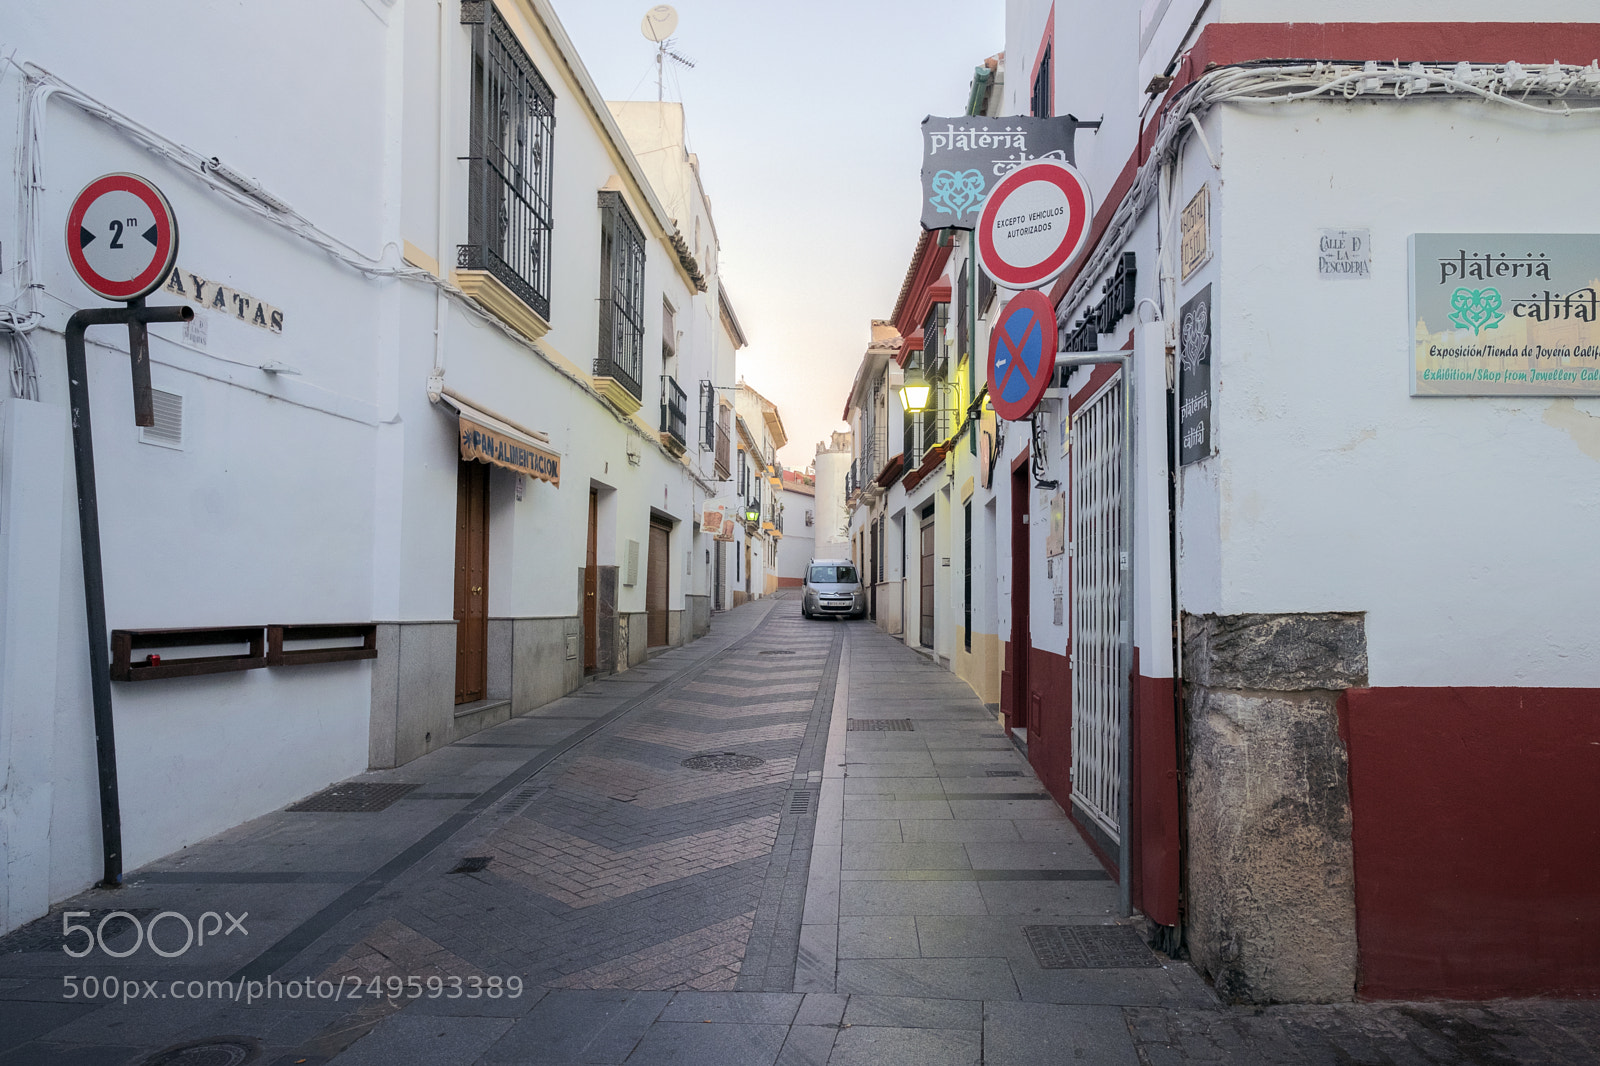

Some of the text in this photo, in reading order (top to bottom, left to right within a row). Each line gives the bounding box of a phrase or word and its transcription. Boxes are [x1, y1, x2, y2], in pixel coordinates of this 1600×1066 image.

[929, 124, 1027, 155] plateria
[997, 206, 1064, 229] EXCEPTO VEHICULOS
[1007, 222, 1052, 239] AUTORIZADOS
[1320, 235, 1346, 252] CALLE
[1337, 250, 1349, 261] LA
[1319, 256, 1369, 276] PESCADERIA
[1438, 249, 1552, 285] plateria
[1511, 287, 1600, 323] califal
[1429, 344, 1600, 360] Exposición/Tienda de Joyería Calif
[1423, 368, 1501, 383] Exhibition/Shop
[1504, 368, 1527, 383] from
[1530, 368, 1578, 384] Jewellery
